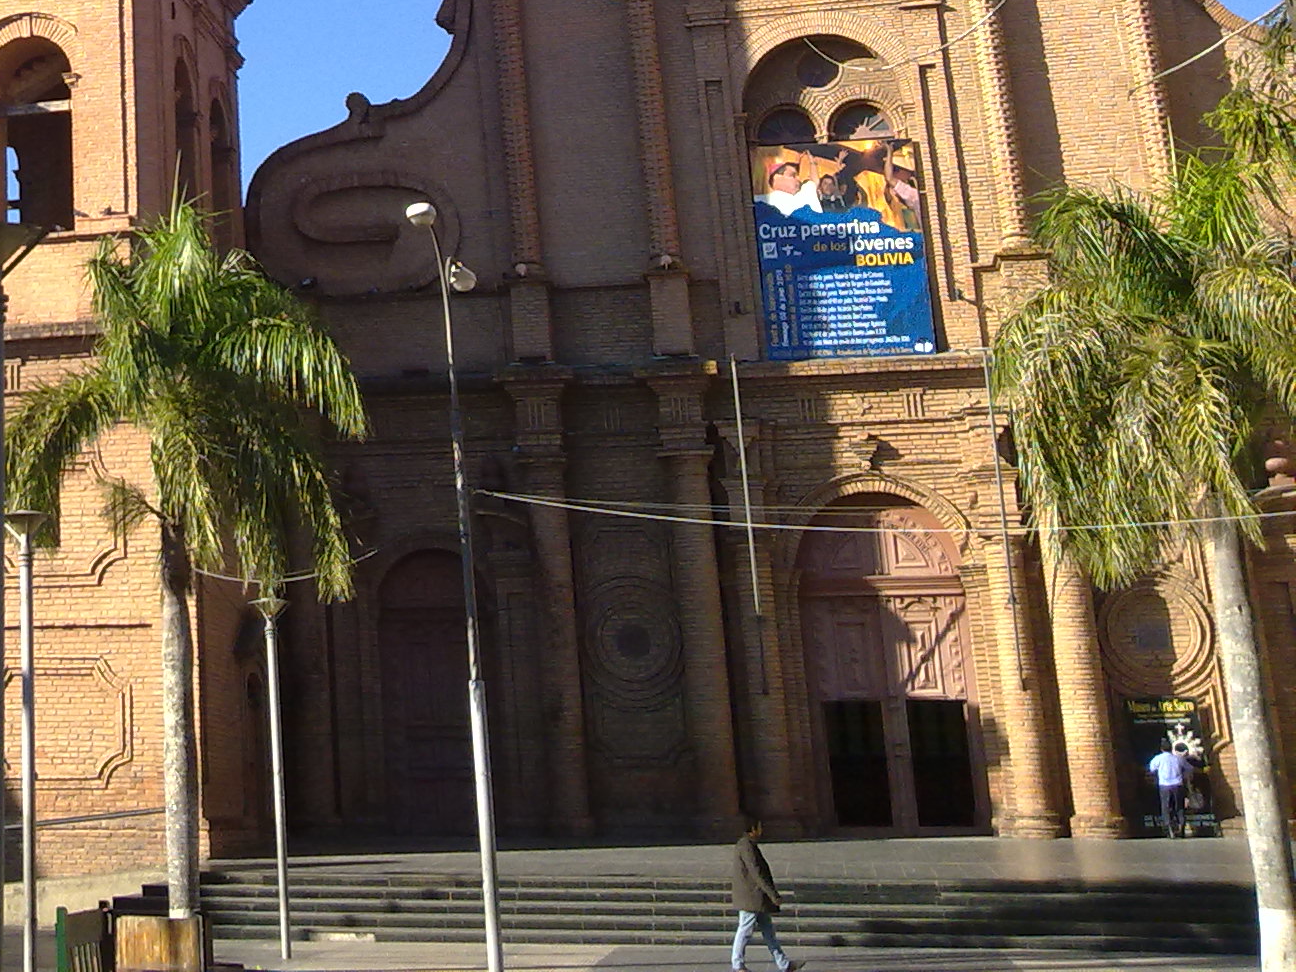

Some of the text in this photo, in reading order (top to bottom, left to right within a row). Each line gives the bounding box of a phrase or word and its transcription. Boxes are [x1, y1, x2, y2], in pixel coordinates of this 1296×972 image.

[759, 219, 880, 240] Cruz peregrina
[813, 241, 827, 252] de
[831, 240, 847, 251] los
[856, 251, 914, 267] BOLIVIA
